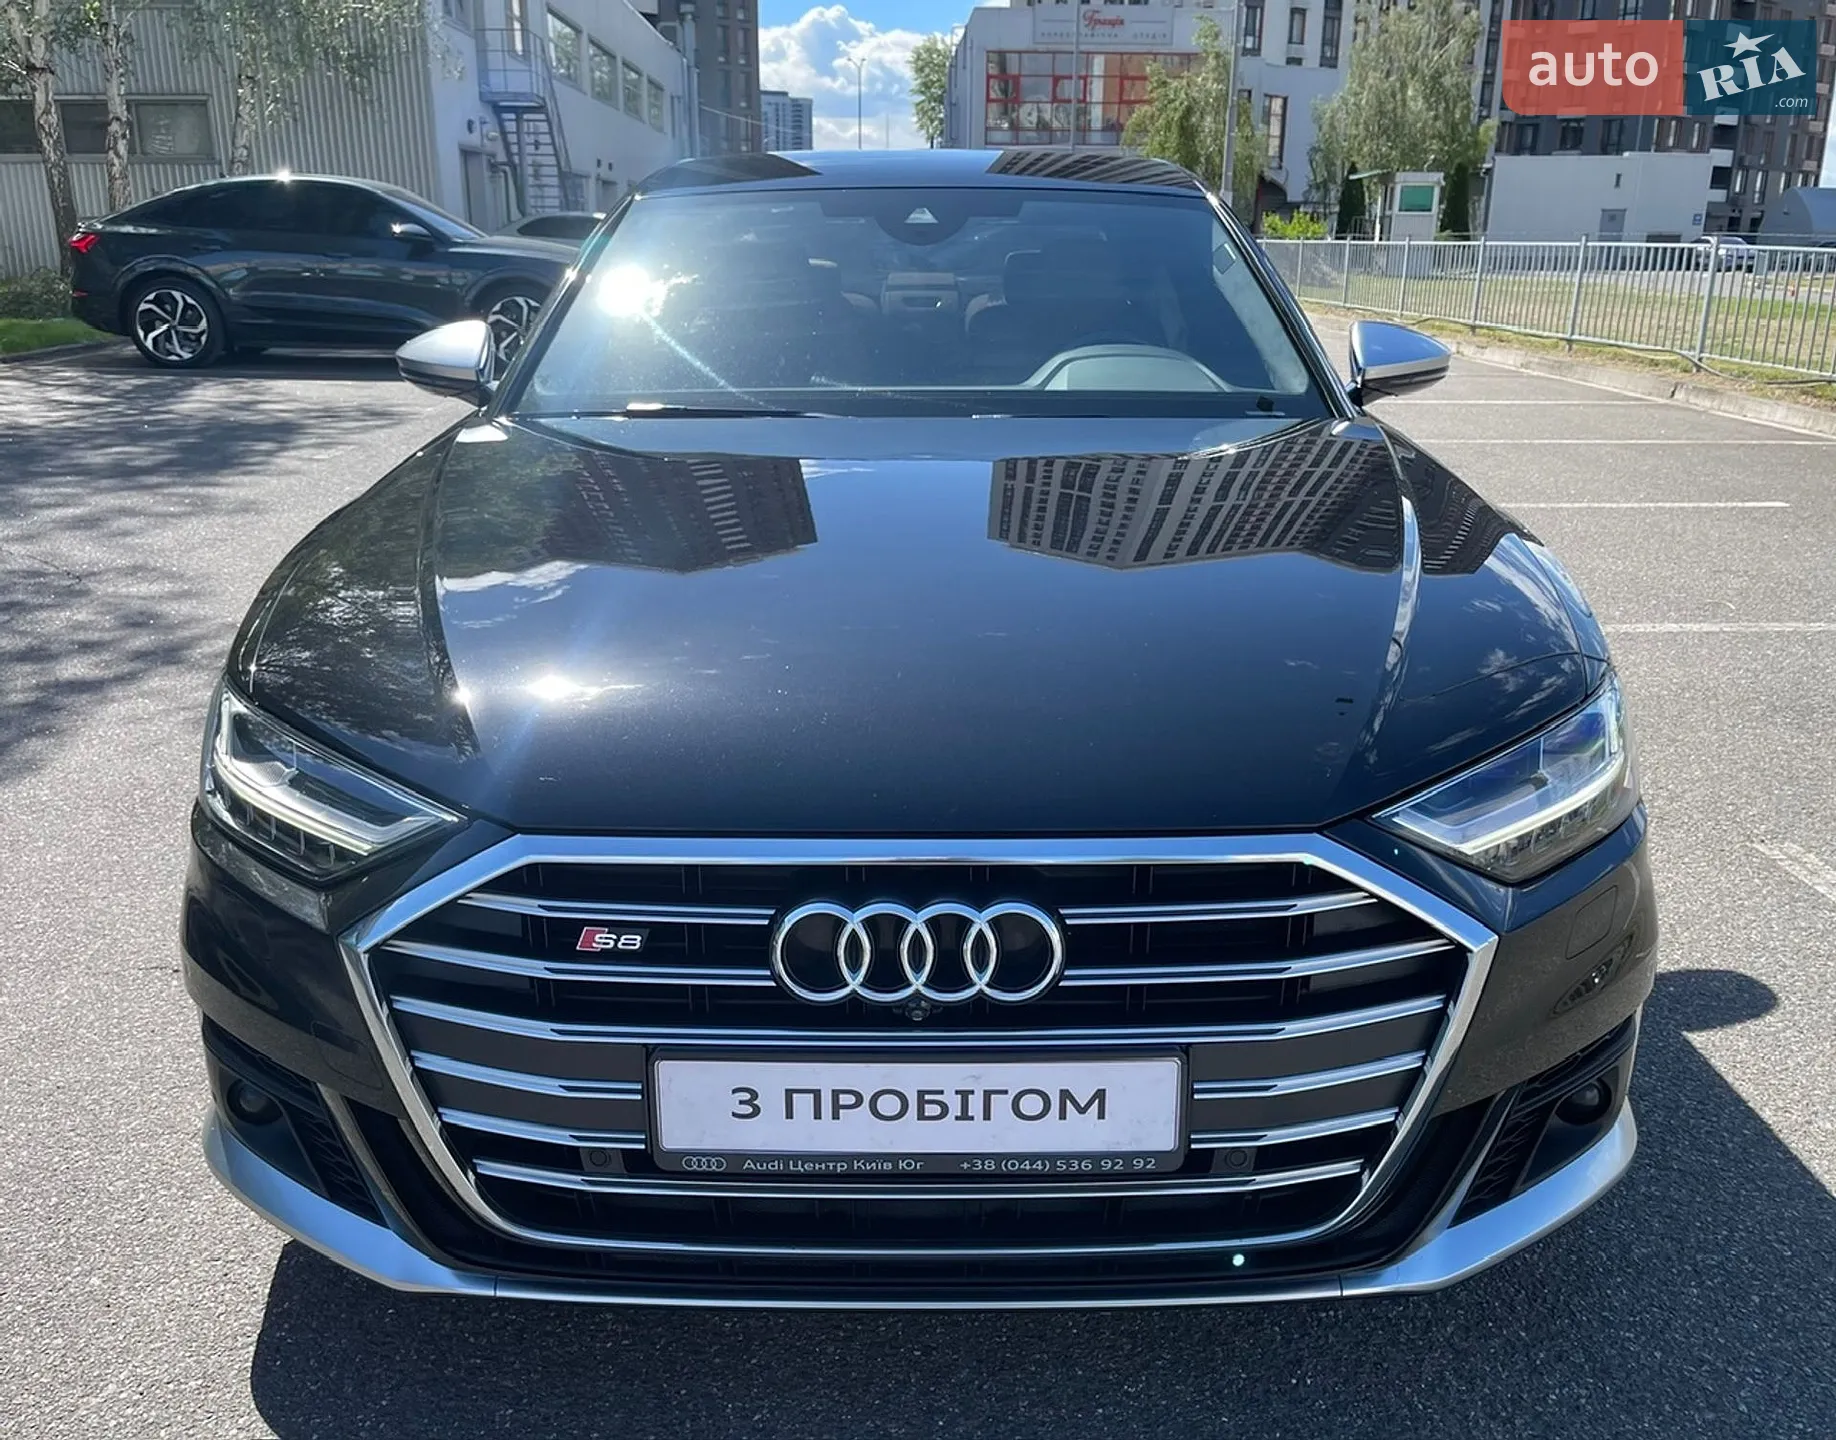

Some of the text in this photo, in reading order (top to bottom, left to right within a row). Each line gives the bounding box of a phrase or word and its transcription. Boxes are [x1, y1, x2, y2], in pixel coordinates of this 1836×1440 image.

[592, 933, 643, 950] S8
[730, 1087, 1108, 1122] З ПРОБІГОМ
[742, 1157, 1157, 1174] Audi Центр Київ Юг +38 (044) 536 92 92
